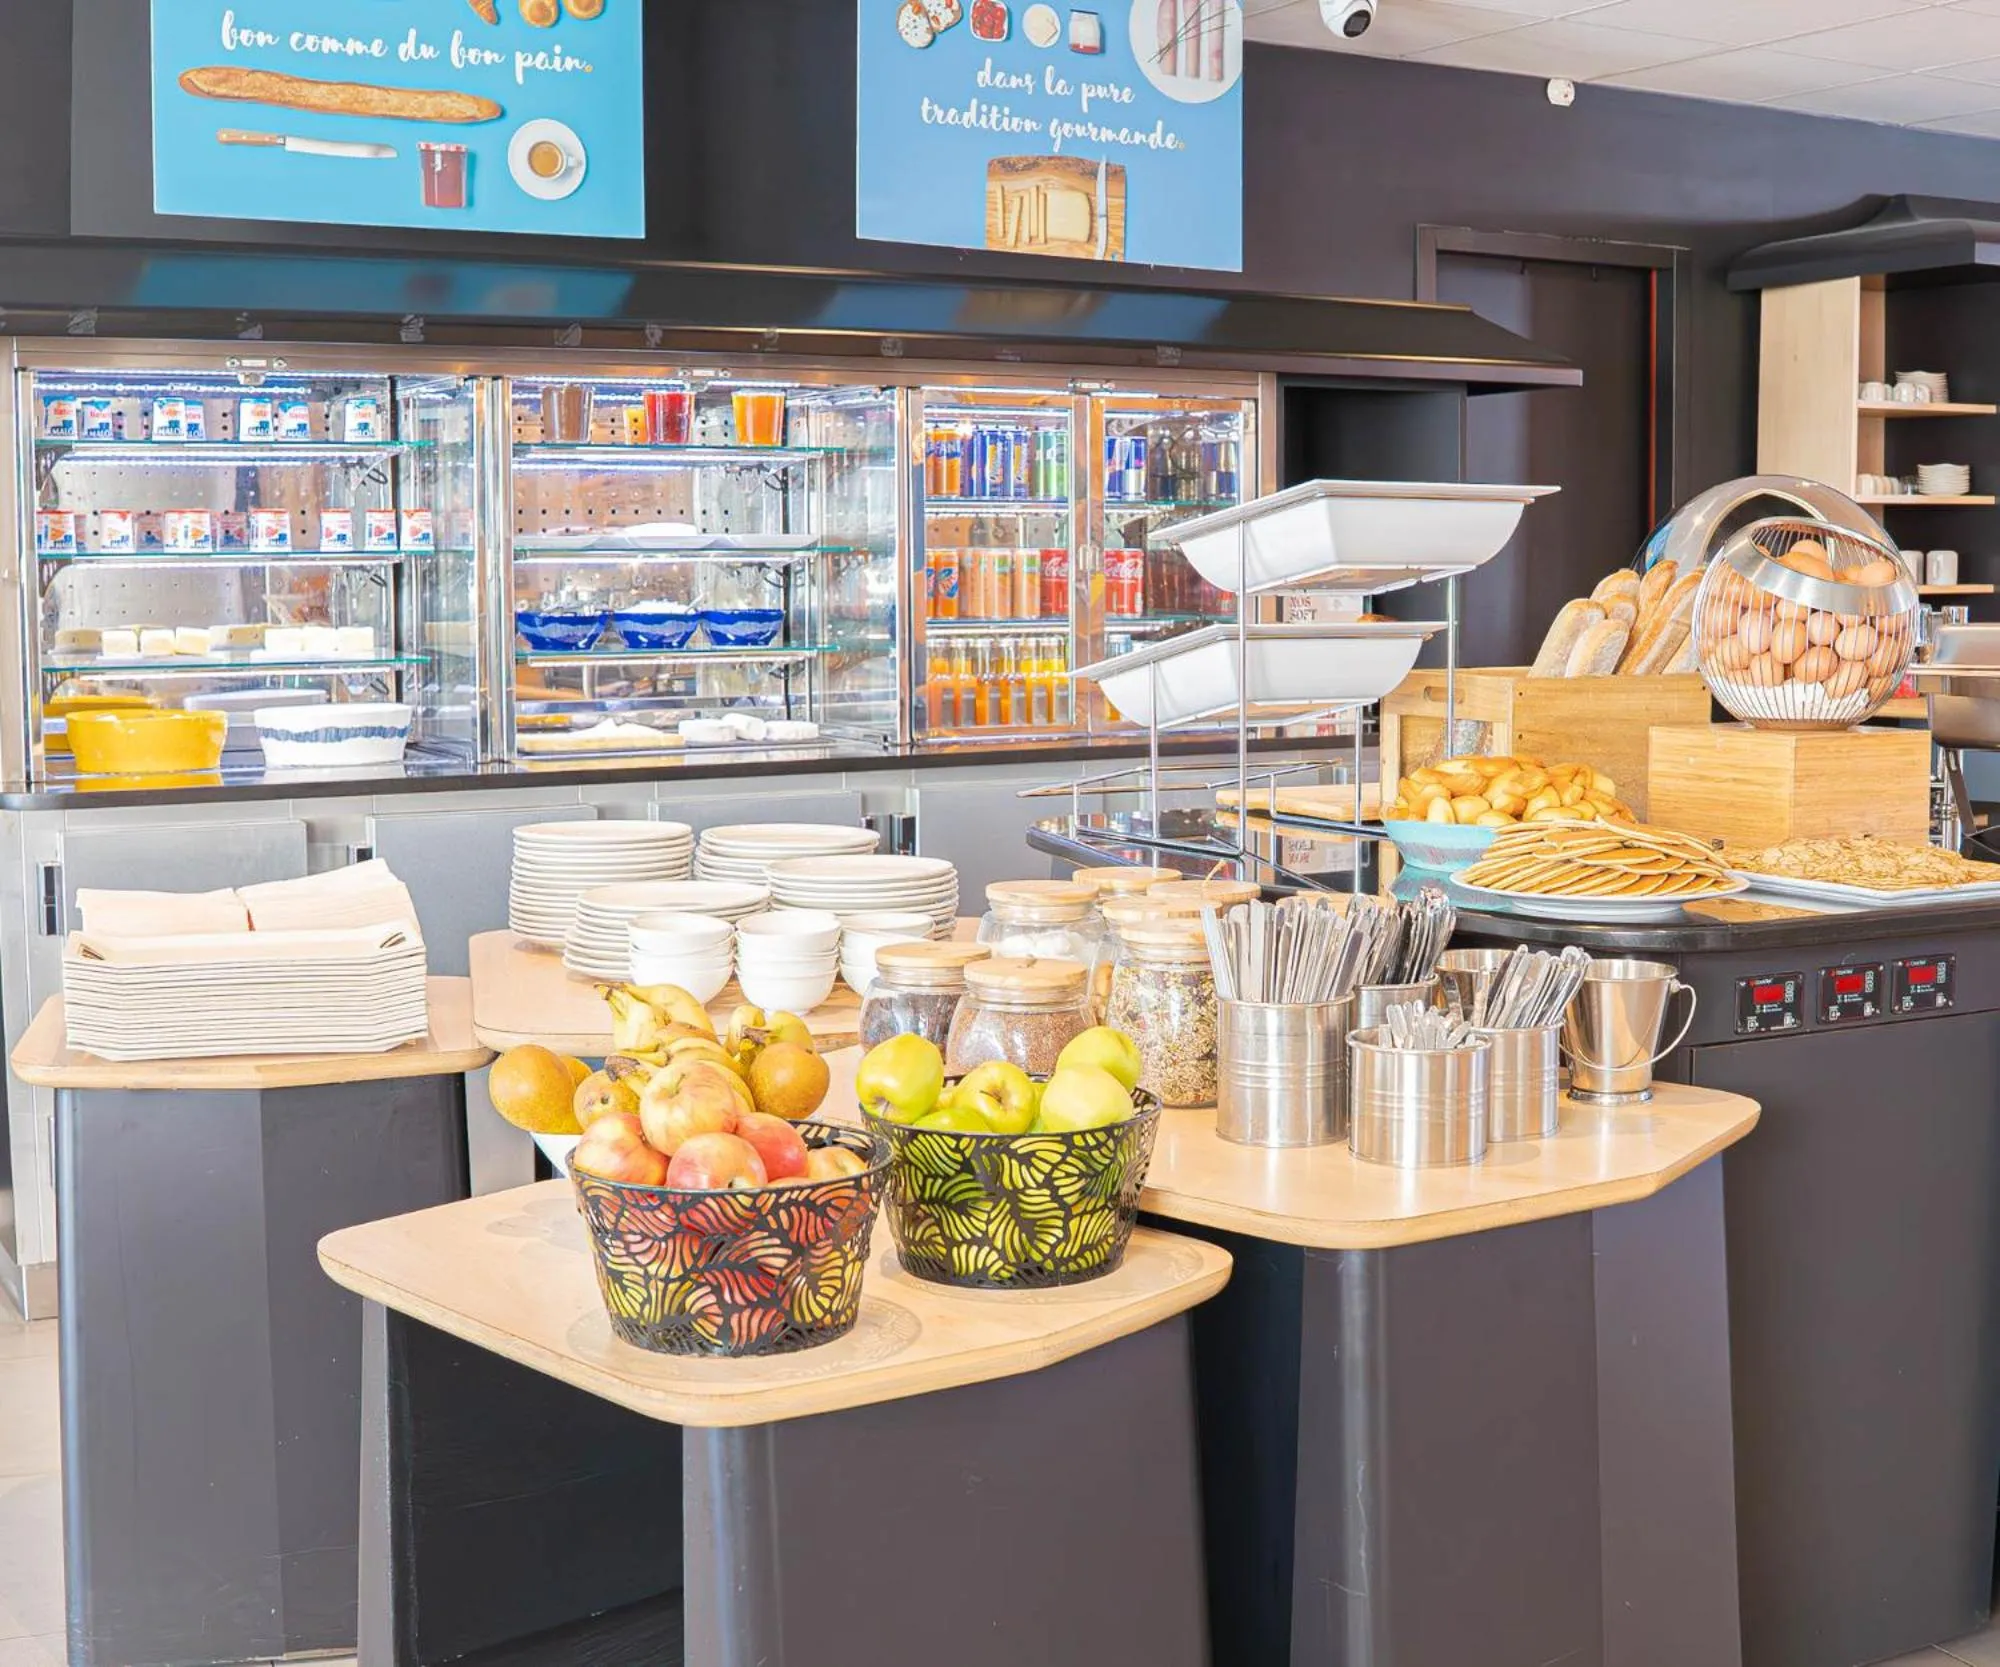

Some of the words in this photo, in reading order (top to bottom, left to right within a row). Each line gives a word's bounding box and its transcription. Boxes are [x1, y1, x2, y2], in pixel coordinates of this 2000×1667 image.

[220, 10, 280, 52] bon
[288, 31, 389, 58] comme
[397, 28, 441, 63] du
[449, 30, 506, 69] bon
[976, 57, 1036, 95] dans
[1043, 65, 1074, 96] la
[1081, 82, 1136, 113] pure
[920, 97, 1042, 133] tradition
